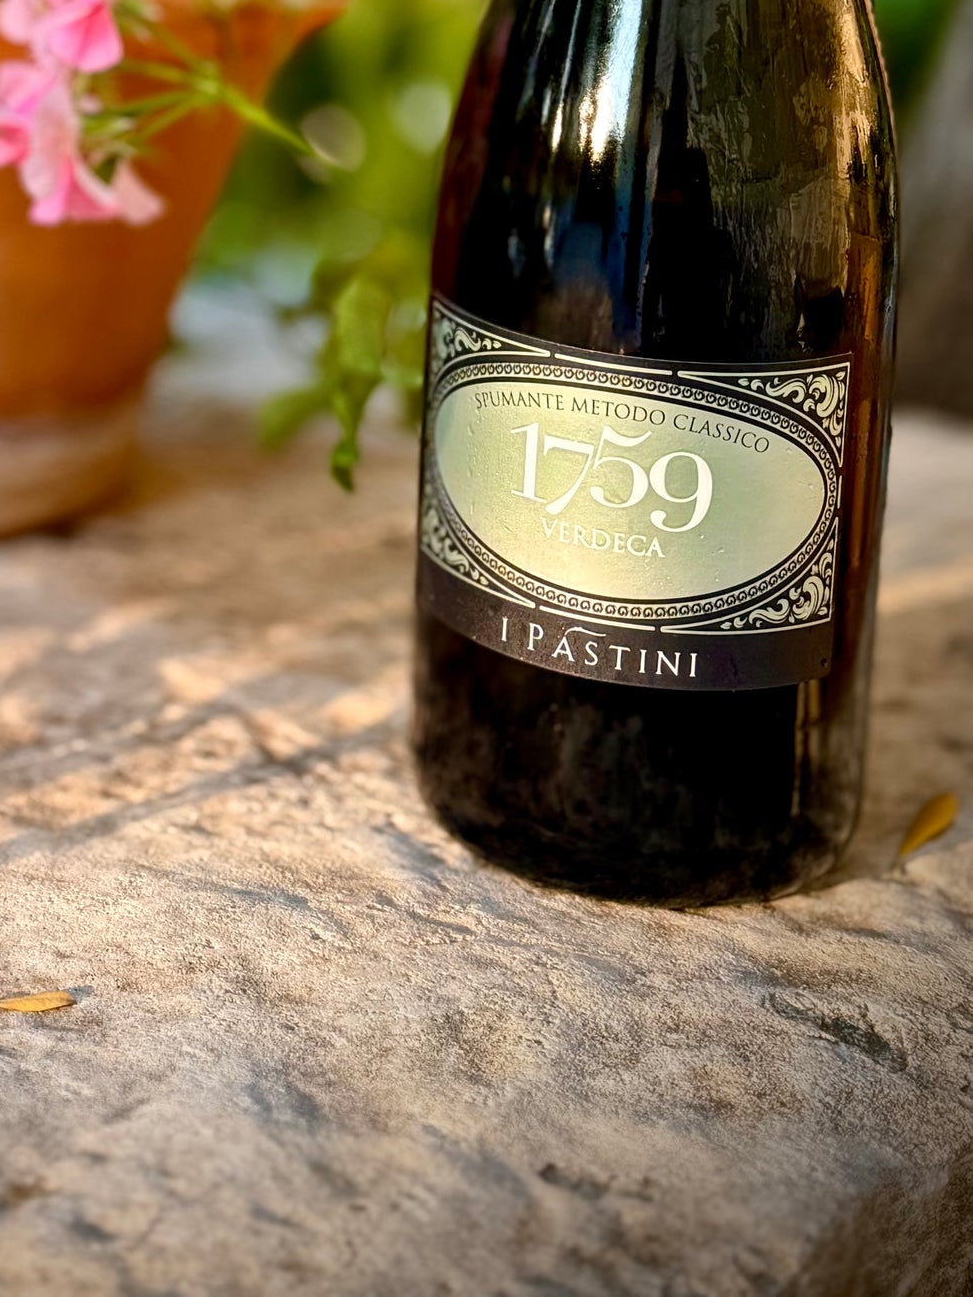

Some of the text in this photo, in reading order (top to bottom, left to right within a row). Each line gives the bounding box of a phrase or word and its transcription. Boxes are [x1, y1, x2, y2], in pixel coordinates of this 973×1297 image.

[475, 391, 771, 454] SPUMANTE METODO CLASSICO
[510, 422, 713, 533] 1759
[541, 518, 666, 558] VERDECA
[501, 616, 699, 678] I PASTINI
